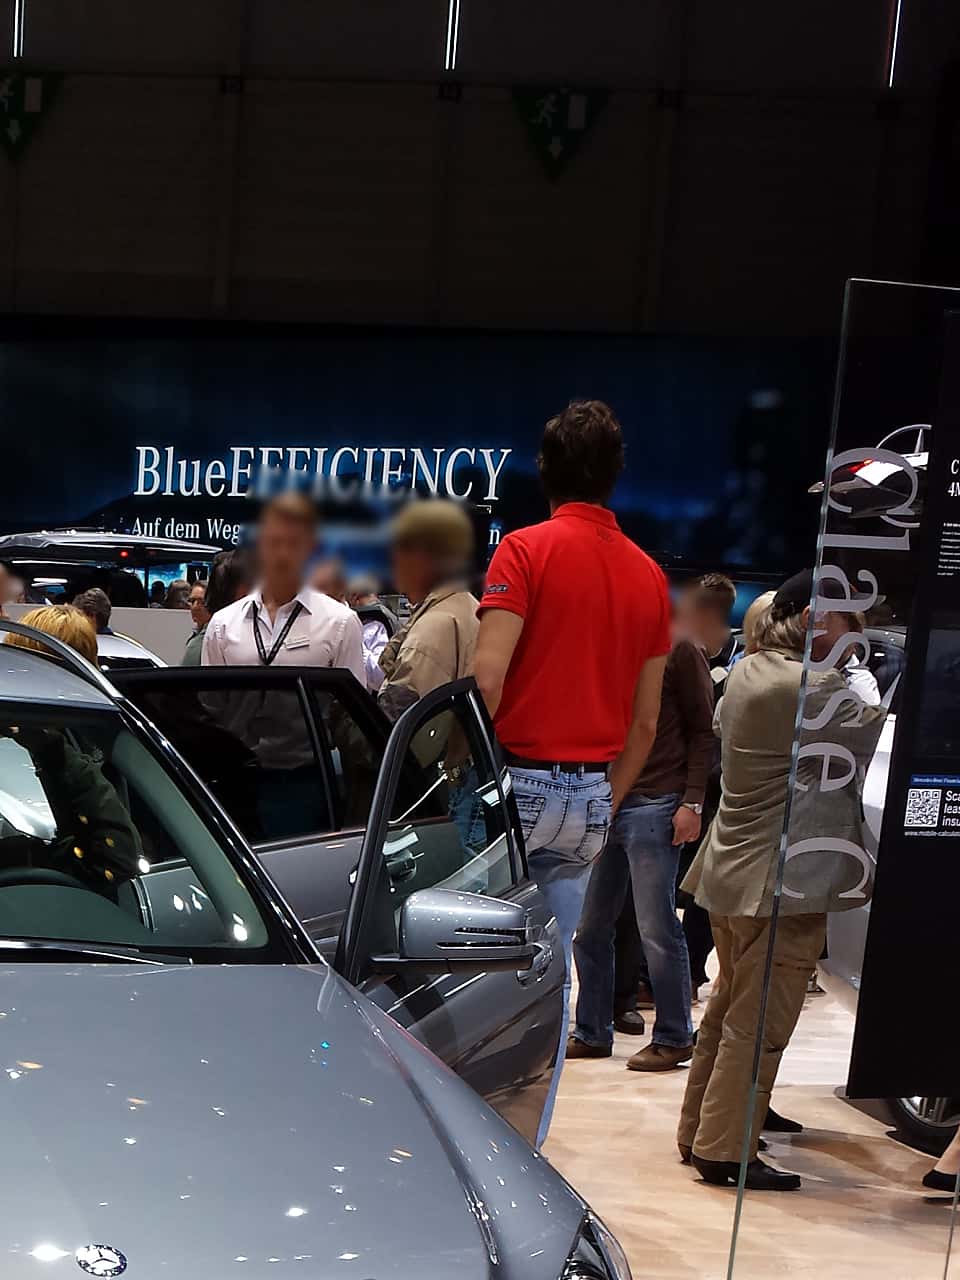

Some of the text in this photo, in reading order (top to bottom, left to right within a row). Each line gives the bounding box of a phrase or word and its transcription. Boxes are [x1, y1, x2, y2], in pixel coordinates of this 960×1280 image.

[132, 517, 161, 537] Auf
[165, 518, 200, 539] dem
[206, 518, 241, 545] Weg
